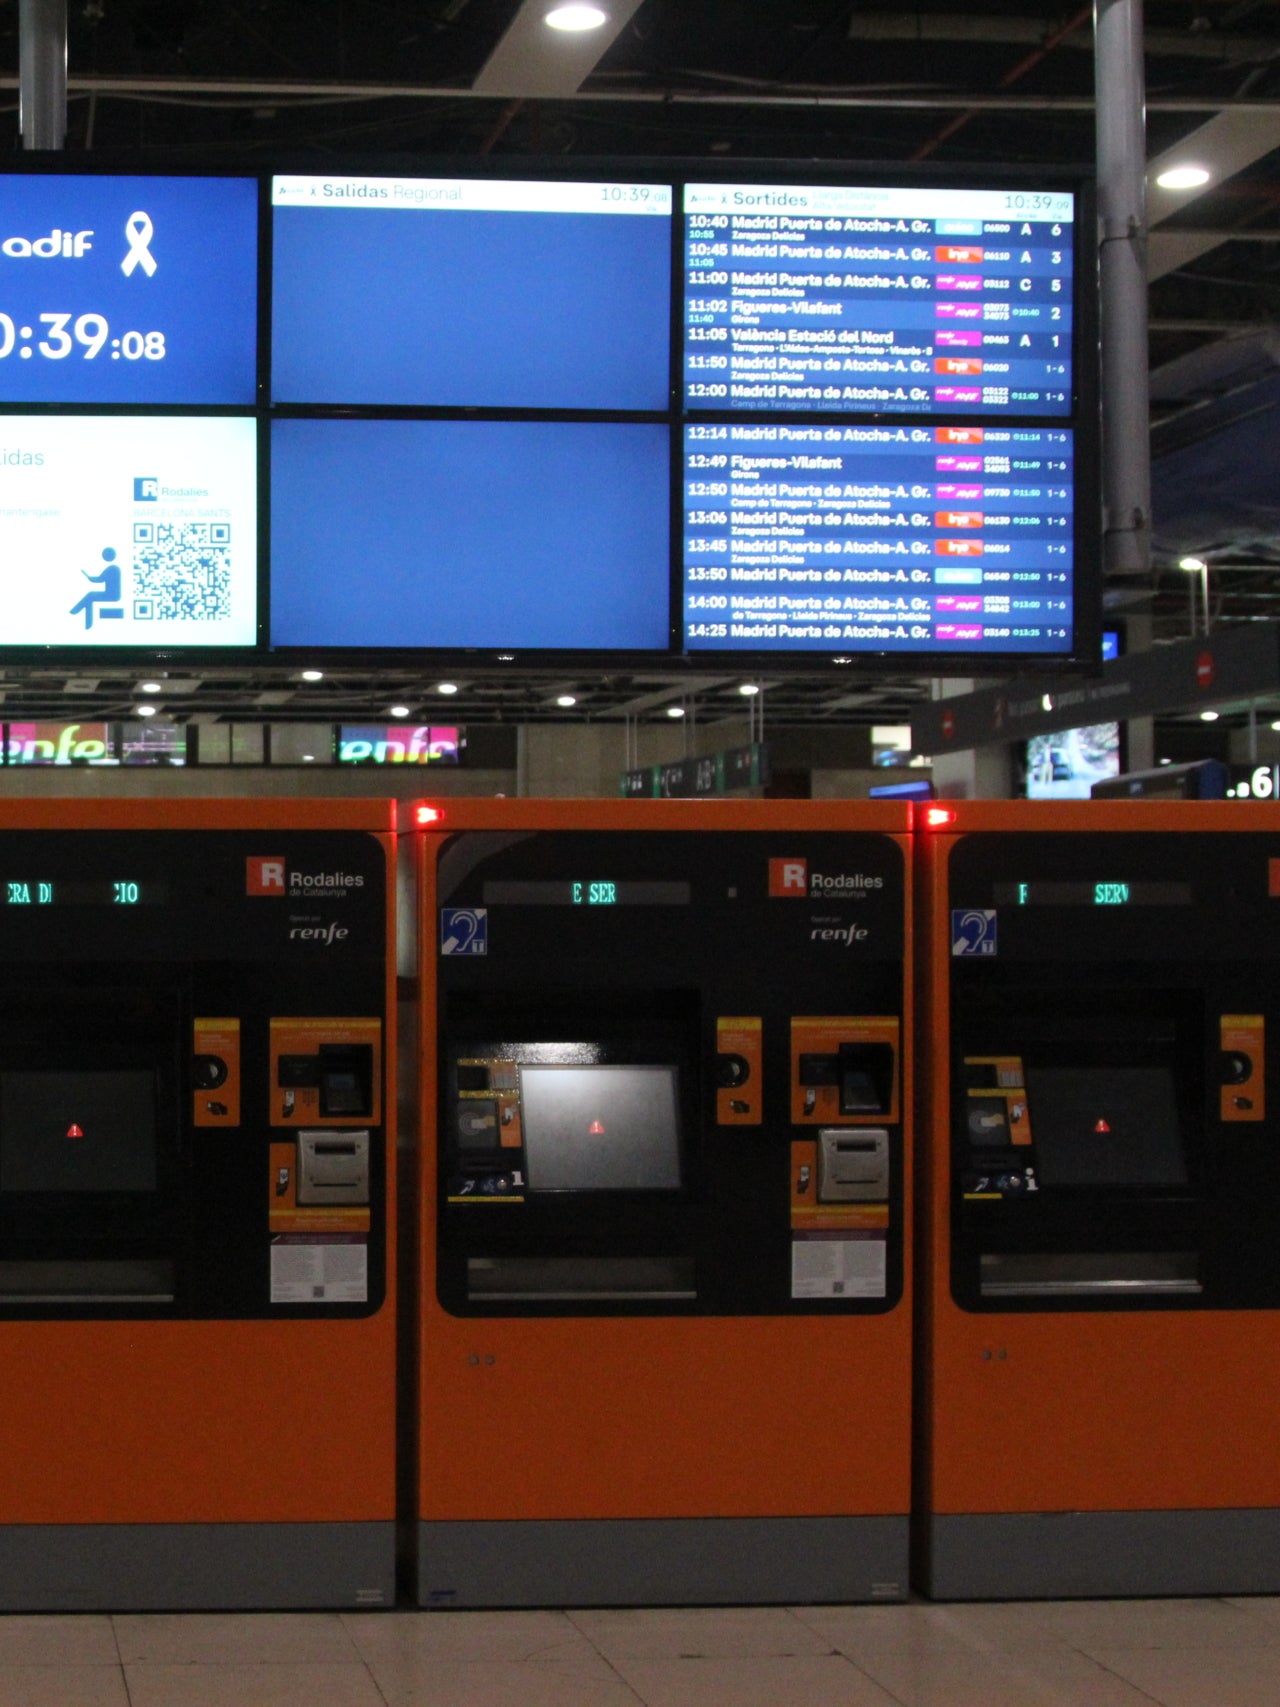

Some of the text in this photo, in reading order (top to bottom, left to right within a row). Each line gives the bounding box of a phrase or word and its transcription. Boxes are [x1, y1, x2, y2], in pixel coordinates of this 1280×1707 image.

[322, 183, 389, 198] Salidas
[393, 184, 462, 202] Regional
[733, 192, 808, 207] Sortides
[688, 216, 728, 229] 10:40
[732, 217, 777, 230] Madrid
[779, 218, 822, 231] Puerta
[824, 219, 841, 232] de
[912, 221, 931, 234] Gr.
[1021, 223, 1032, 236] A
[1051, 224, 1062, 236] 6
[1, 229, 94, 258] adif
[688, 244, 728, 257] 10:45
[732, 245, 777, 258] Madrid
[779, 246, 822, 259] Puerta
[824, 246, 841, 259] de
[912, 249, 931, 262] Gr.
[1021, 251, 1032, 263] A
[1051, 252, 1062, 264] 3
[688, 272, 728, 285] 11:00
[732, 273, 777, 286] Madrid
[779, 274, 822, 287] Puerta
[824, 274, 841, 287] de
[912, 276, 931, 289] Gr.
[1020, 278, 1032, 290] C
[1051, 279, 1062, 292] 5
[688, 300, 728, 314] 11:02
[1051, 307, 1061, 320] 2
[688, 328, 728, 342] 11:05
[732, 329, 894, 345] València Estació del Nord
[1020, 334, 1031, 346] A
[1052, 335, 1059, 347] 1
[688, 356, 728, 369] 11:50
[732, 357, 777, 370] Madrid
[779, 358, 822, 371] Puerta
[824, 358, 841, 371] de
[912, 360, 931, 373] Gr.
[688, 384, 728, 397] 12:00
[732, 385, 777, 398] Madrid
[779, 385, 822, 398] Puerta
[824, 386, 841, 399] de
[912, 387, 931, 400] Gr.
[688, 427, 728, 440] 12:14
[732, 428, 777, 441] Madrid
[779, 429, 822, 442] Puerta
[824, 429, 841, 442] de
[912, 431, 931, 444] Gr.
[688, 455, 728, 468] 12:49
[161, 487, 209, 496] Rodalies
[688, 484, 728, 497] 12:50
[732, 484, 777, 497] Madrid
[779, 485, 822, 498] Puerta
[824, 485, 841, 498] de
[912, 486, 931, 499] Gr.
[688, 512, 728, 525] 13:06
[732, 512, 777, 525] Madrid
[779, 513, 822, 526] Puerta
[824, 513, 841, 526] de
[912, 514, 931, 527] Gr.
[688, 540, 728, 553] 13:45
[732, 540, 777, 553] Madrid
[779, 541, 822, 554] Puerta
[824, 541, 841, 554] de
[912, 542, 931, 555] Gr.
[688, 568, 728, 581] 13:50
[732, 568, 777, 581] Madrid
[779, 568, 822, 581] Puerta
[824, 569, 841, 582] de
[912, 570, 931, 583] Gr.
[688, 596, 728, 609] 14:00
[732, 596, 777, 609] Madrid
[779, 596, 822, 609] Puerta
[824, 597, 841, 610] de
[912, 598, 931, 611] Gr.
[688, 624, 728, 637] 14:25
[732, 624, 777, 637] Madrid
[779, 625, 822, 638] Puerta
[824, 625, 841, 638] de
[912, 626, 931, 639] Gr.
[339, 726, 457, 764] enfe
[290, 872, 364, 887] Rodalies
[810, 874, 882, 888] Rodalies
[290, 888, 347, 898] de Catalunya
[810, 889, 866, 899] de Catalunya
[290, 922, 349, 946] renfe
[810, 922, 868, 946] renfe
